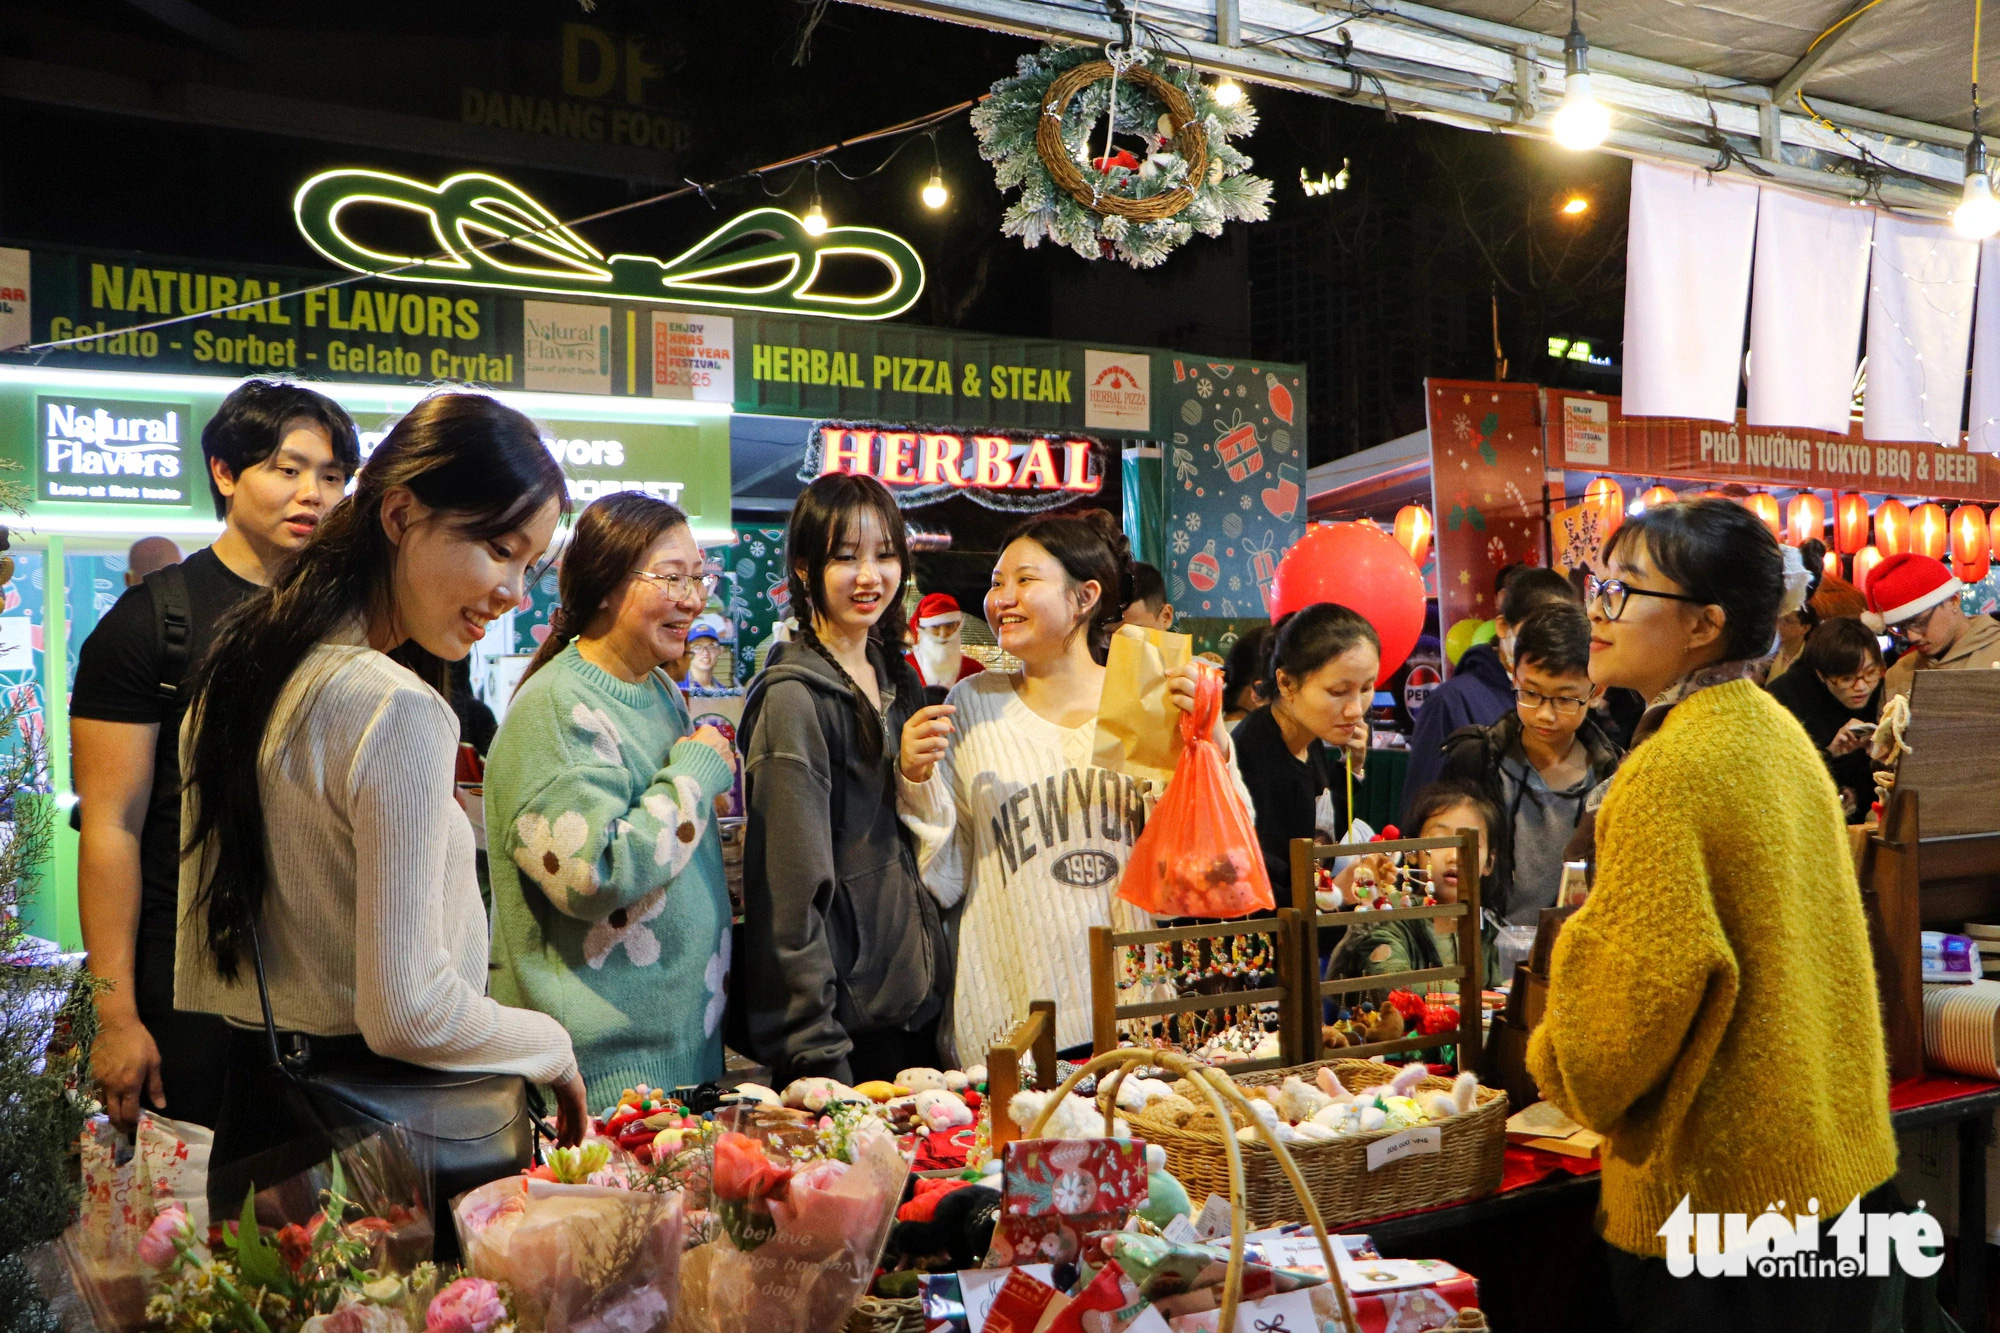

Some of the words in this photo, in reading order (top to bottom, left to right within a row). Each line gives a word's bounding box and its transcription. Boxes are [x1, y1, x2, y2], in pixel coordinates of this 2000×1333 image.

[461, 86, 604, 143] DANANG
[91, 262, 291, 325] NATURAL
[304, 287, 480, 340] FLAVORS
[527, 318, 594, 342] Natural
[668, 322, 704, 333] ENJOY
[668, 333, 704, 346] XMAS
[50, 315, 159, 358] Gelato
[193, 329, 297, 369] Sorbet
[328, 340, 420, 376] Gelato
[431, 348, 514, 382] Crytal
[668, 346, 695, 357] NEW
[697, 348, 730, 359] YEAR
[668, 357, 721, 370] FESTIVAL
[752, 344, 864, 388] HERBAL
[873, 354, 953, 396] PIZZA
[961, 363, 982, 398] &
[990, 365, 1072, 403] STEAK
[1090, 389, 1122, 404] HERBAL
[1124, 392, 1146, 406] PIZZA
[47, 403, 179, 444] Natural
[47, 438, 180, 477] Flavors
[818, 427, 1101, 493] HERBAL
[1700, 422, 1740, 464] PHỐ
[1745, 431, 1811, 471] NƯỚNG
[1815, 441, 1871, 475] TOKYO
[1876, 447, 1911, 481] BBQ
[1916, 451, 1929, 481] &
[1934, 452, 1977, 483] BEER
[1064, 854, 1107, 884] 1996
